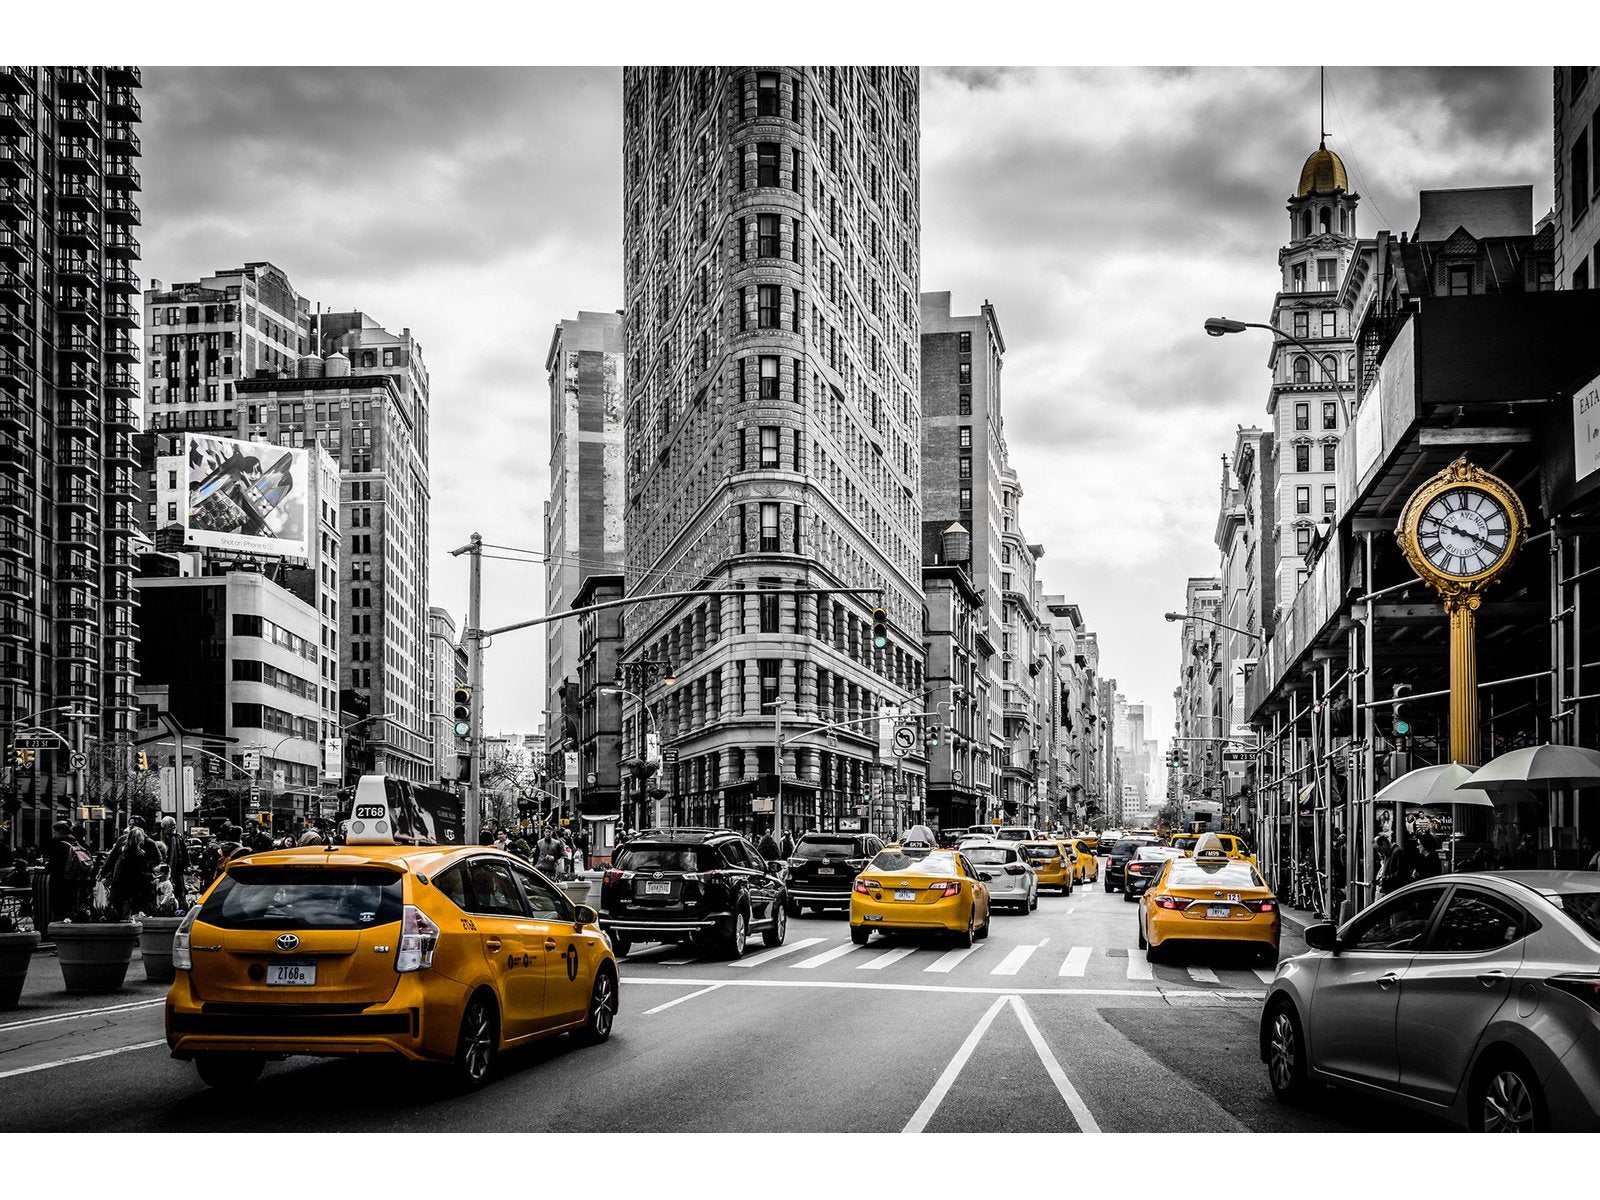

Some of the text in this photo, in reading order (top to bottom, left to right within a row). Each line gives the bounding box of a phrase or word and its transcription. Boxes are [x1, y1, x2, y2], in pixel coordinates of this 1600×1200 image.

[1460, 511, 1486, 530] AVENUE
[1446, 542, 1482, 556] BUILDING
[357, 807, 384, 817] 2T68
